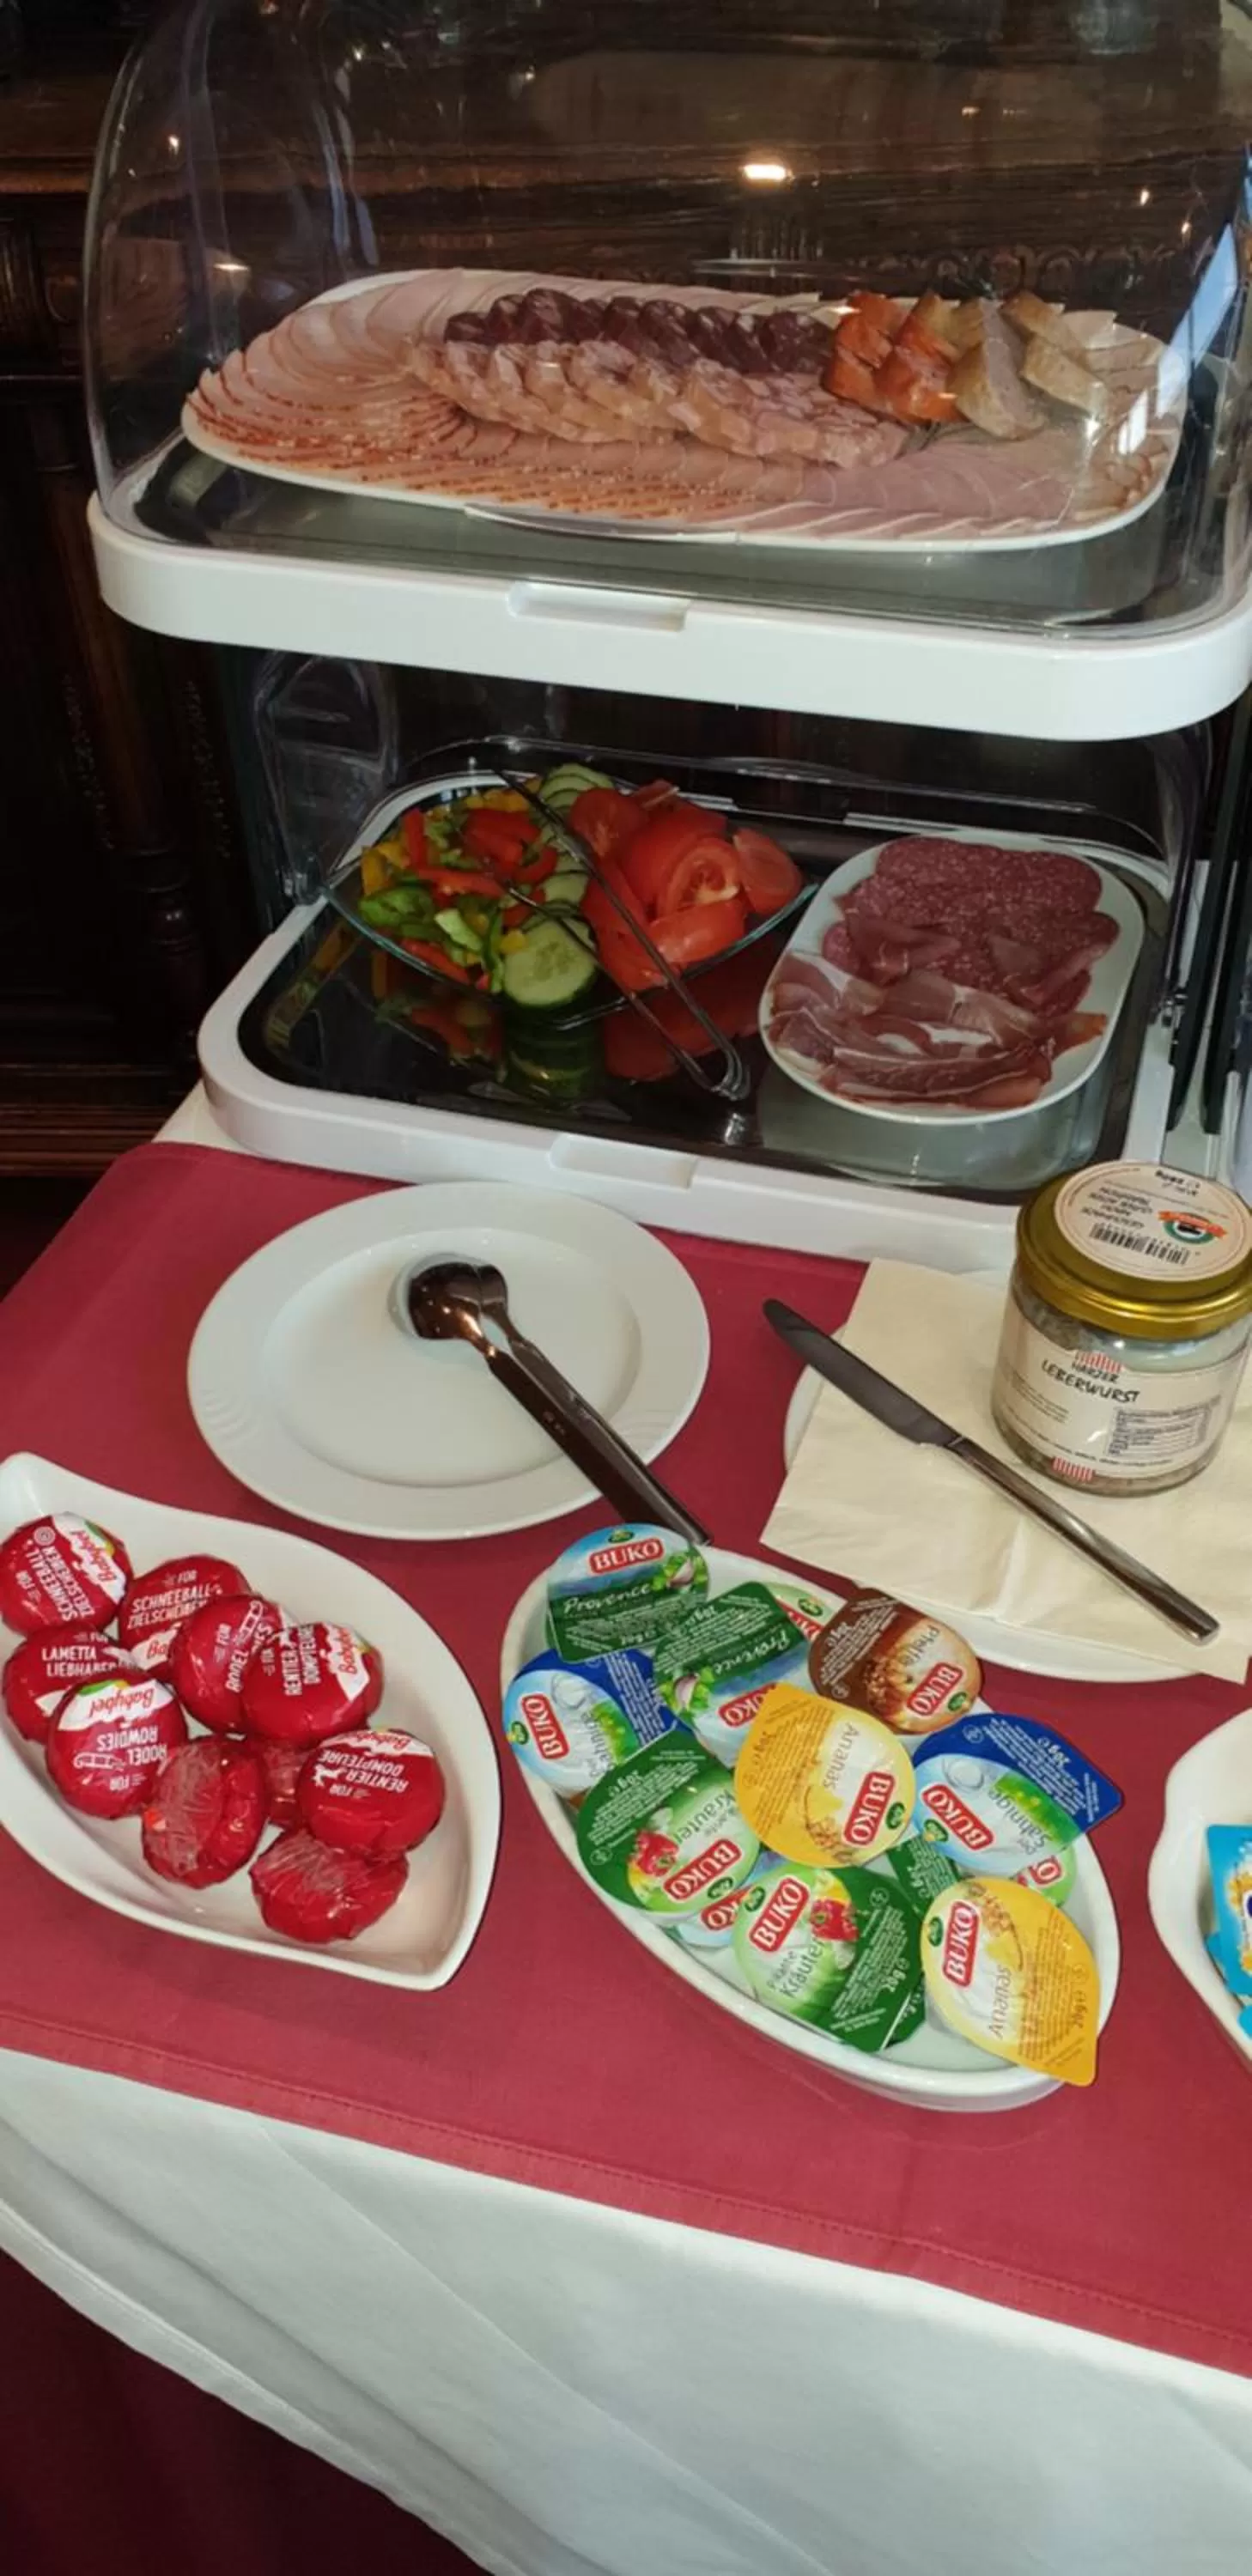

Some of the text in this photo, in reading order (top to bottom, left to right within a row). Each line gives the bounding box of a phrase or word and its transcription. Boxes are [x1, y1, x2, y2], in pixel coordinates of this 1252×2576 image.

[1041, 1359, 1140, 1404] LEBERWURST
[593, 1540, 660, 1571] BUKO
[562, 1583, 651, 1615] Provence
[714, 1630, 791, 1675] Provence
[89, 1688, 156, 1717] Babybel
[911, 1667, 961, 1714] BUKO
[522, 1698, 563, 1758] BUKO
[822, 1722, 861, 1789] Ananas
[849, 1775, 892, 1843] BUKO
[927, 1787, 989, 1847] BUKO
[667, 1843, 737, 1898] BUKO
[754, 1880, 804, 1948] BUKO
[945, 1905, 975, 1982] BUKO
[988, 1963, 1012, 2040] Ananas
